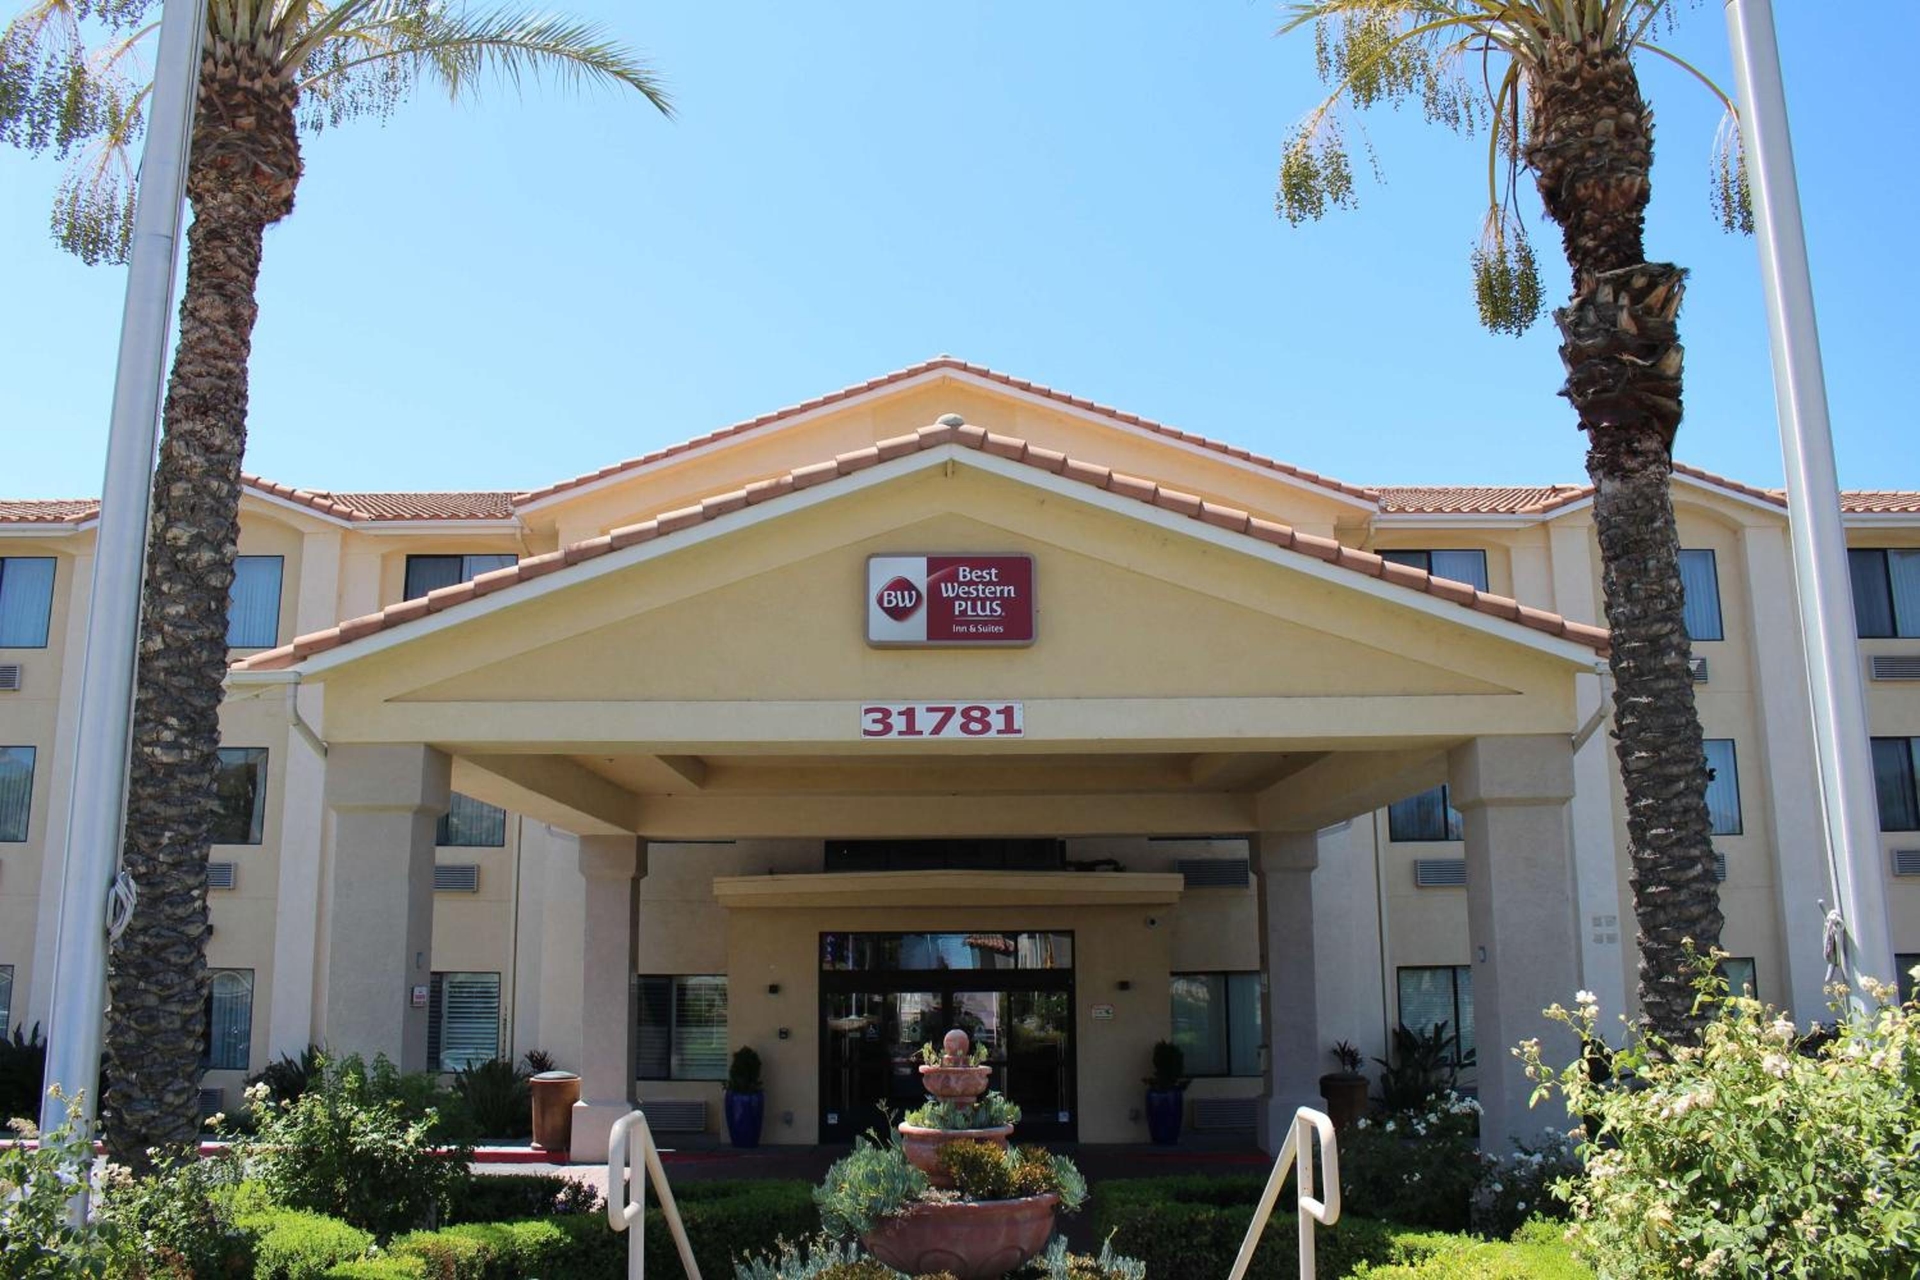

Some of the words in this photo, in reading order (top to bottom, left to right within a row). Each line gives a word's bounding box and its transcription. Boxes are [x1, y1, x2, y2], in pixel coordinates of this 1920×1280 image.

[958, 566, 999, 582] Best
[940, 582, 1016, 598] Western
[883, 590, 917, 608] BW
[954, 600, 1002, 616] PLUS
[952, 624, 968, 633] Inn
[969, 624, 977, 633] &
[977, 624, 1004, 633] Suites
[863, 705, 1022, 736] 31781
